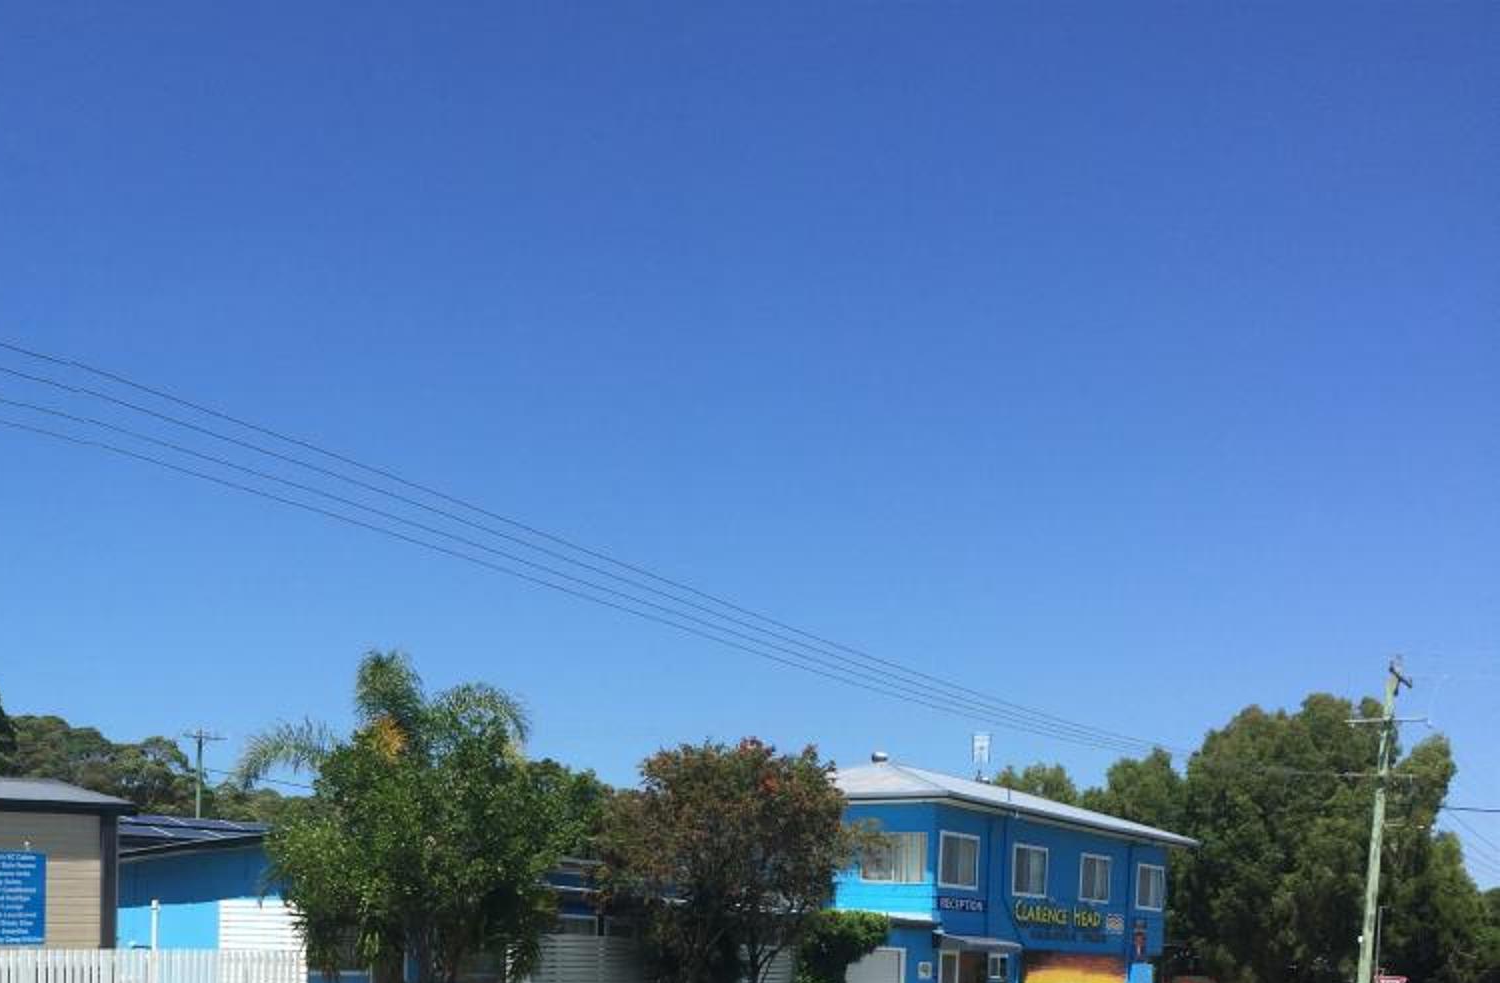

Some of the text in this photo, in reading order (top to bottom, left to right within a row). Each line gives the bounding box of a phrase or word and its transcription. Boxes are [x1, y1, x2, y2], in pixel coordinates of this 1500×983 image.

[940, 897, 983, 911] RECEPTION
[1015, 900, 1067, 925] CLARENCE
[1073, 905, 1101, 927] HEAD
